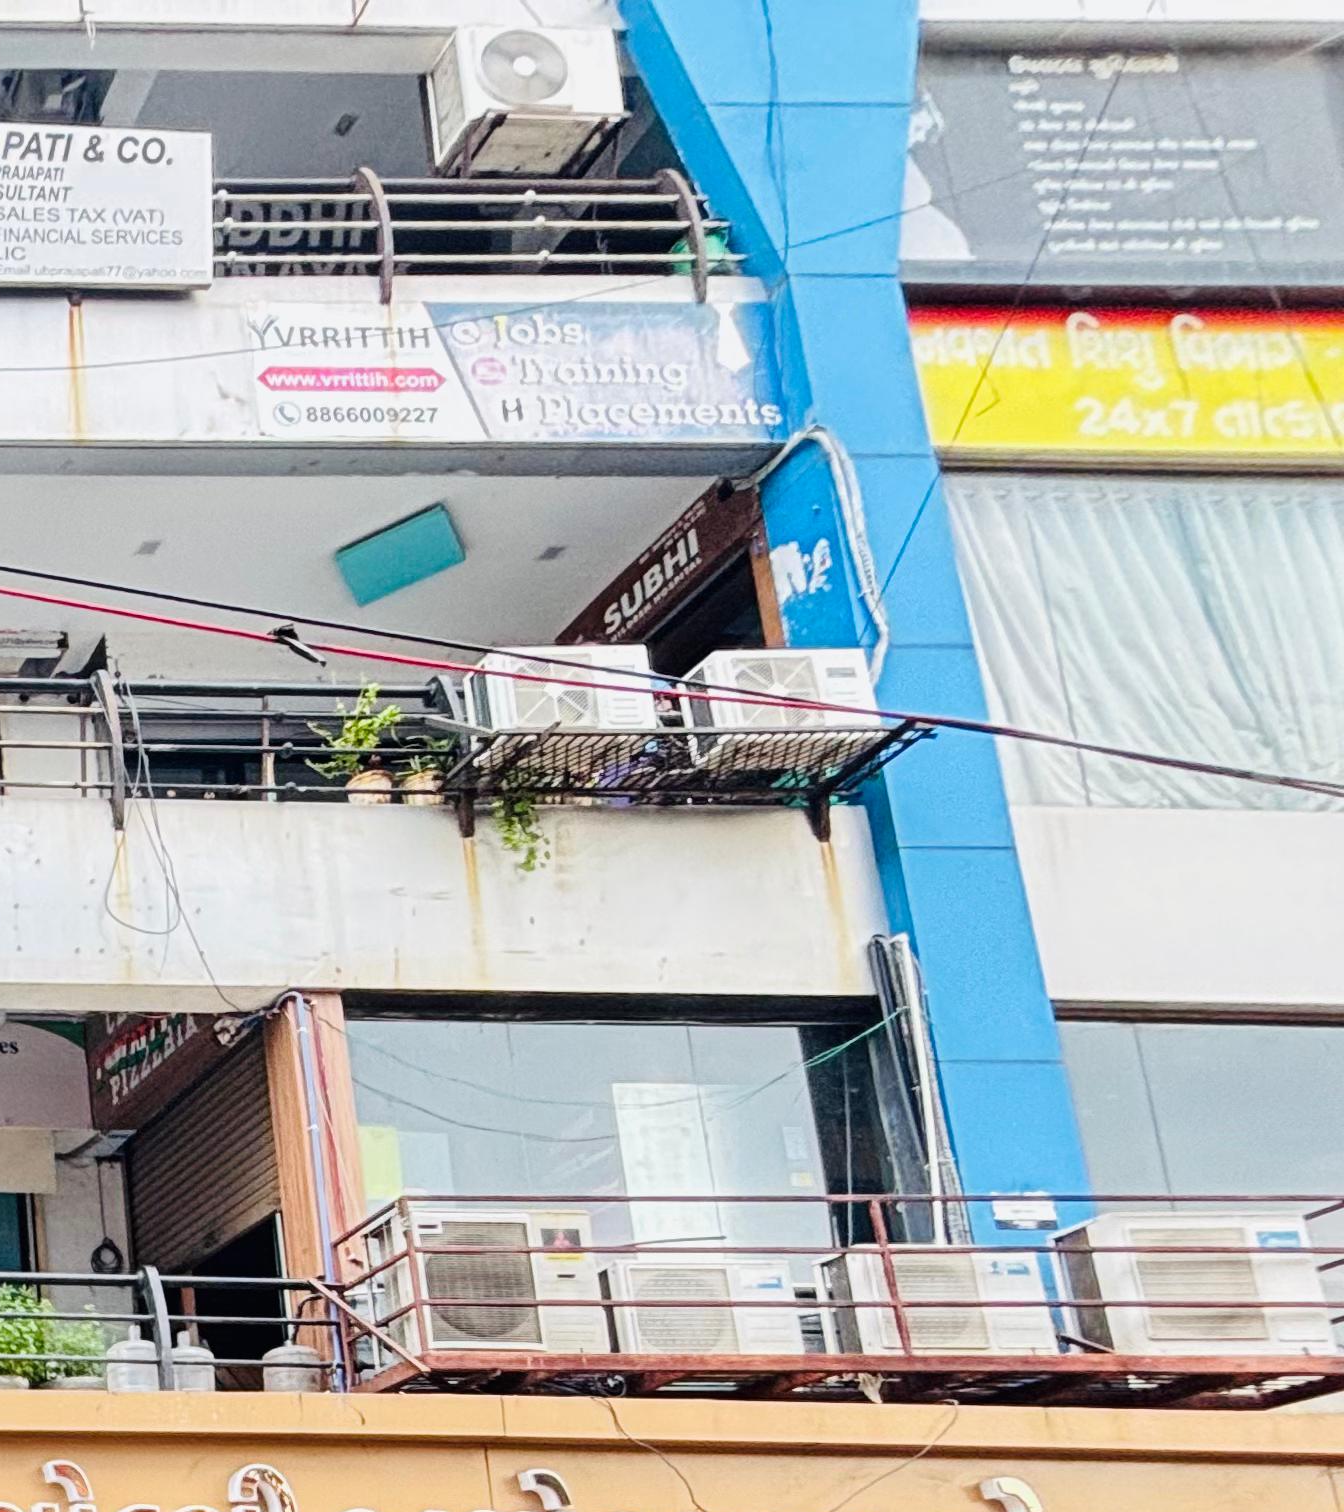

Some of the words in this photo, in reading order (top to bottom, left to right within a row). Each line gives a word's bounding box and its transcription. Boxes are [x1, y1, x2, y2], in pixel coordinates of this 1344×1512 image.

[82, 138, 105, 163] &
[116, 136, 175, 166] CO.
[66, 208, 108, 224] TAX
[112, 208, 165, 227] (VAT)
[91, 229, 183, 246] SERVICES
[493, 314, 586, 348] Jobs
[266, 371, 439, 390] www.vrrittih.com
[512, 358, 689, 391] Training
[305, 405, 439, 424] 8866009227
[539, 397, 783, 428] Placements
[603, 527, 701, 636] SUBHI
